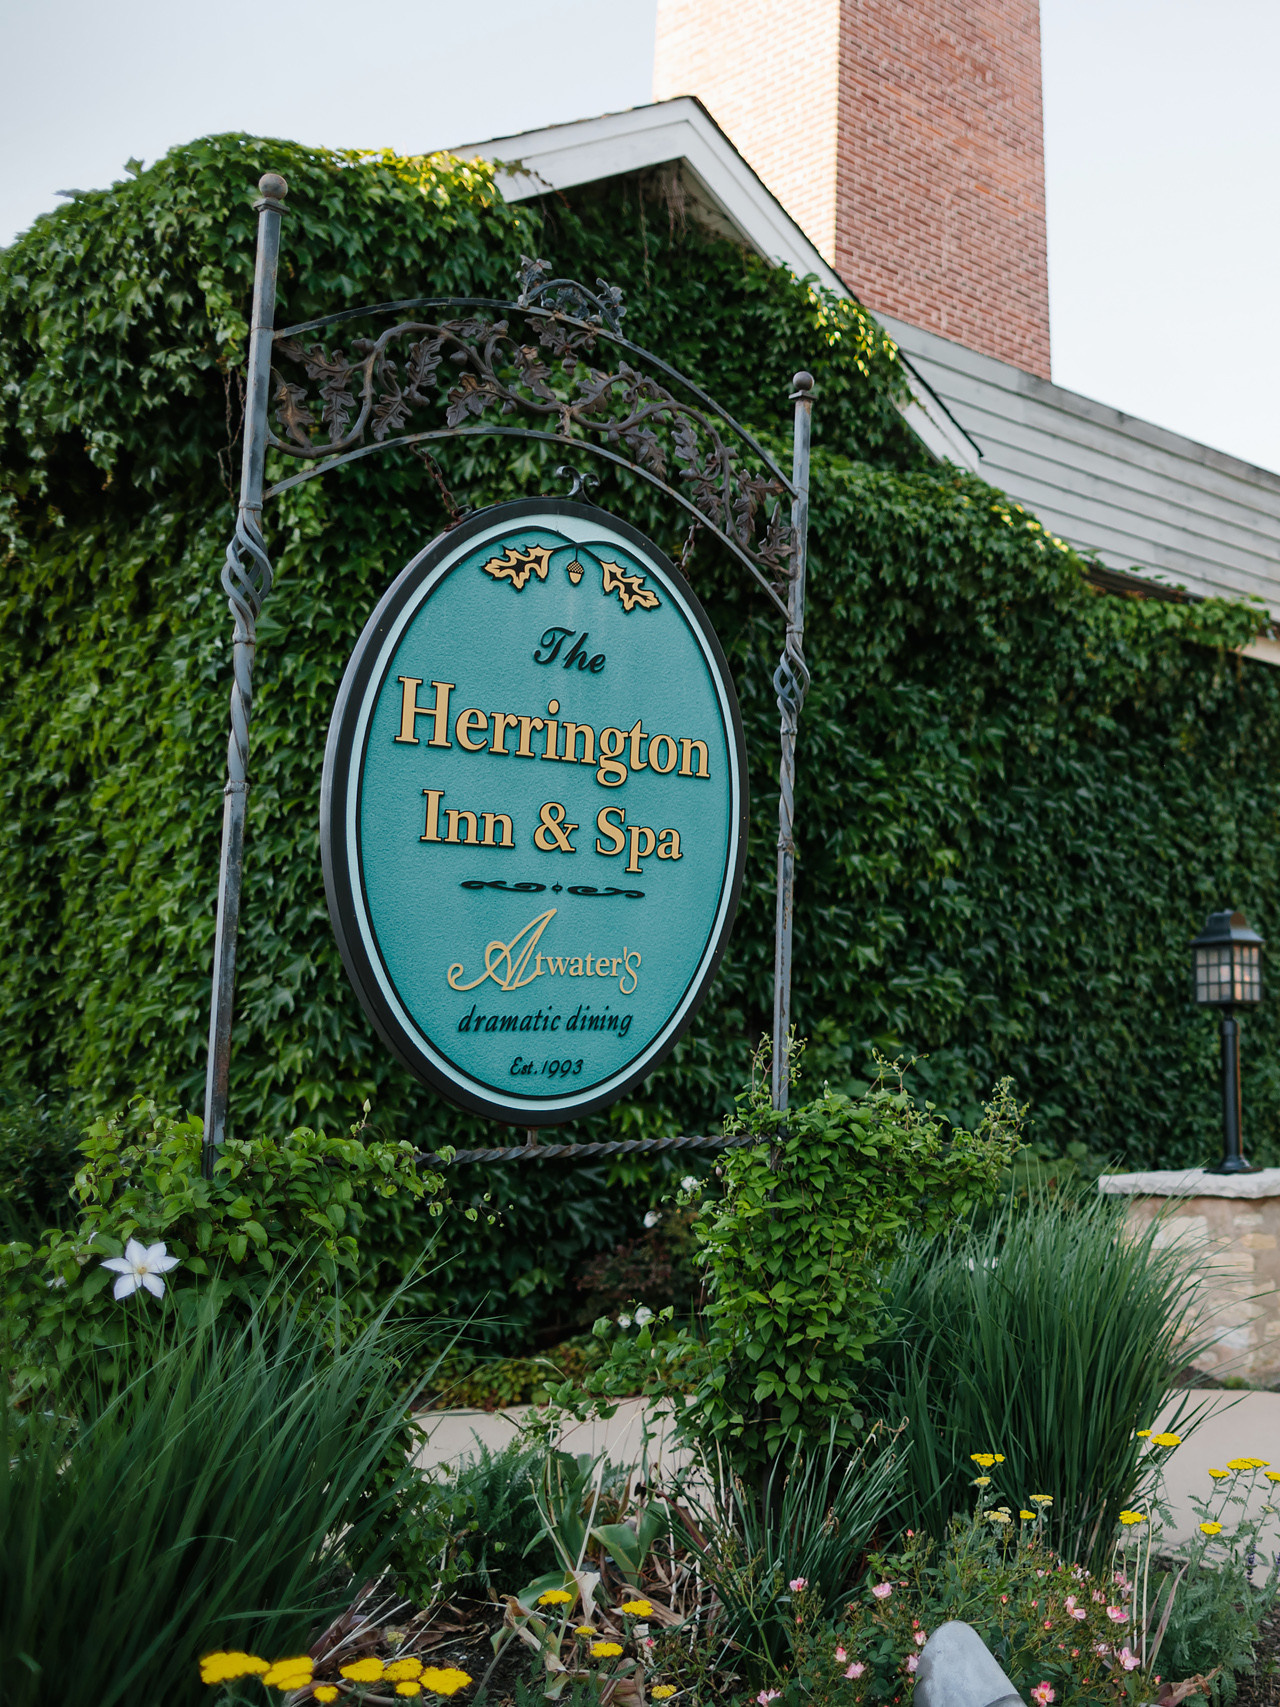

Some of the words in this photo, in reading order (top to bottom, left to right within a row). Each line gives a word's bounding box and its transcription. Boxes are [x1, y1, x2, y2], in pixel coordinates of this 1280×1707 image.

[534, 627, 606, 672] The
[395, 676, 711, 787] Herrington
[420, 789, 515, 848] Inn
[533, 801, 579, 853] &
[596, 806, 683, 873] Spa
[457, 1004, 561, 1033] dramatic
[565, 1005, 634, 1037] dining
